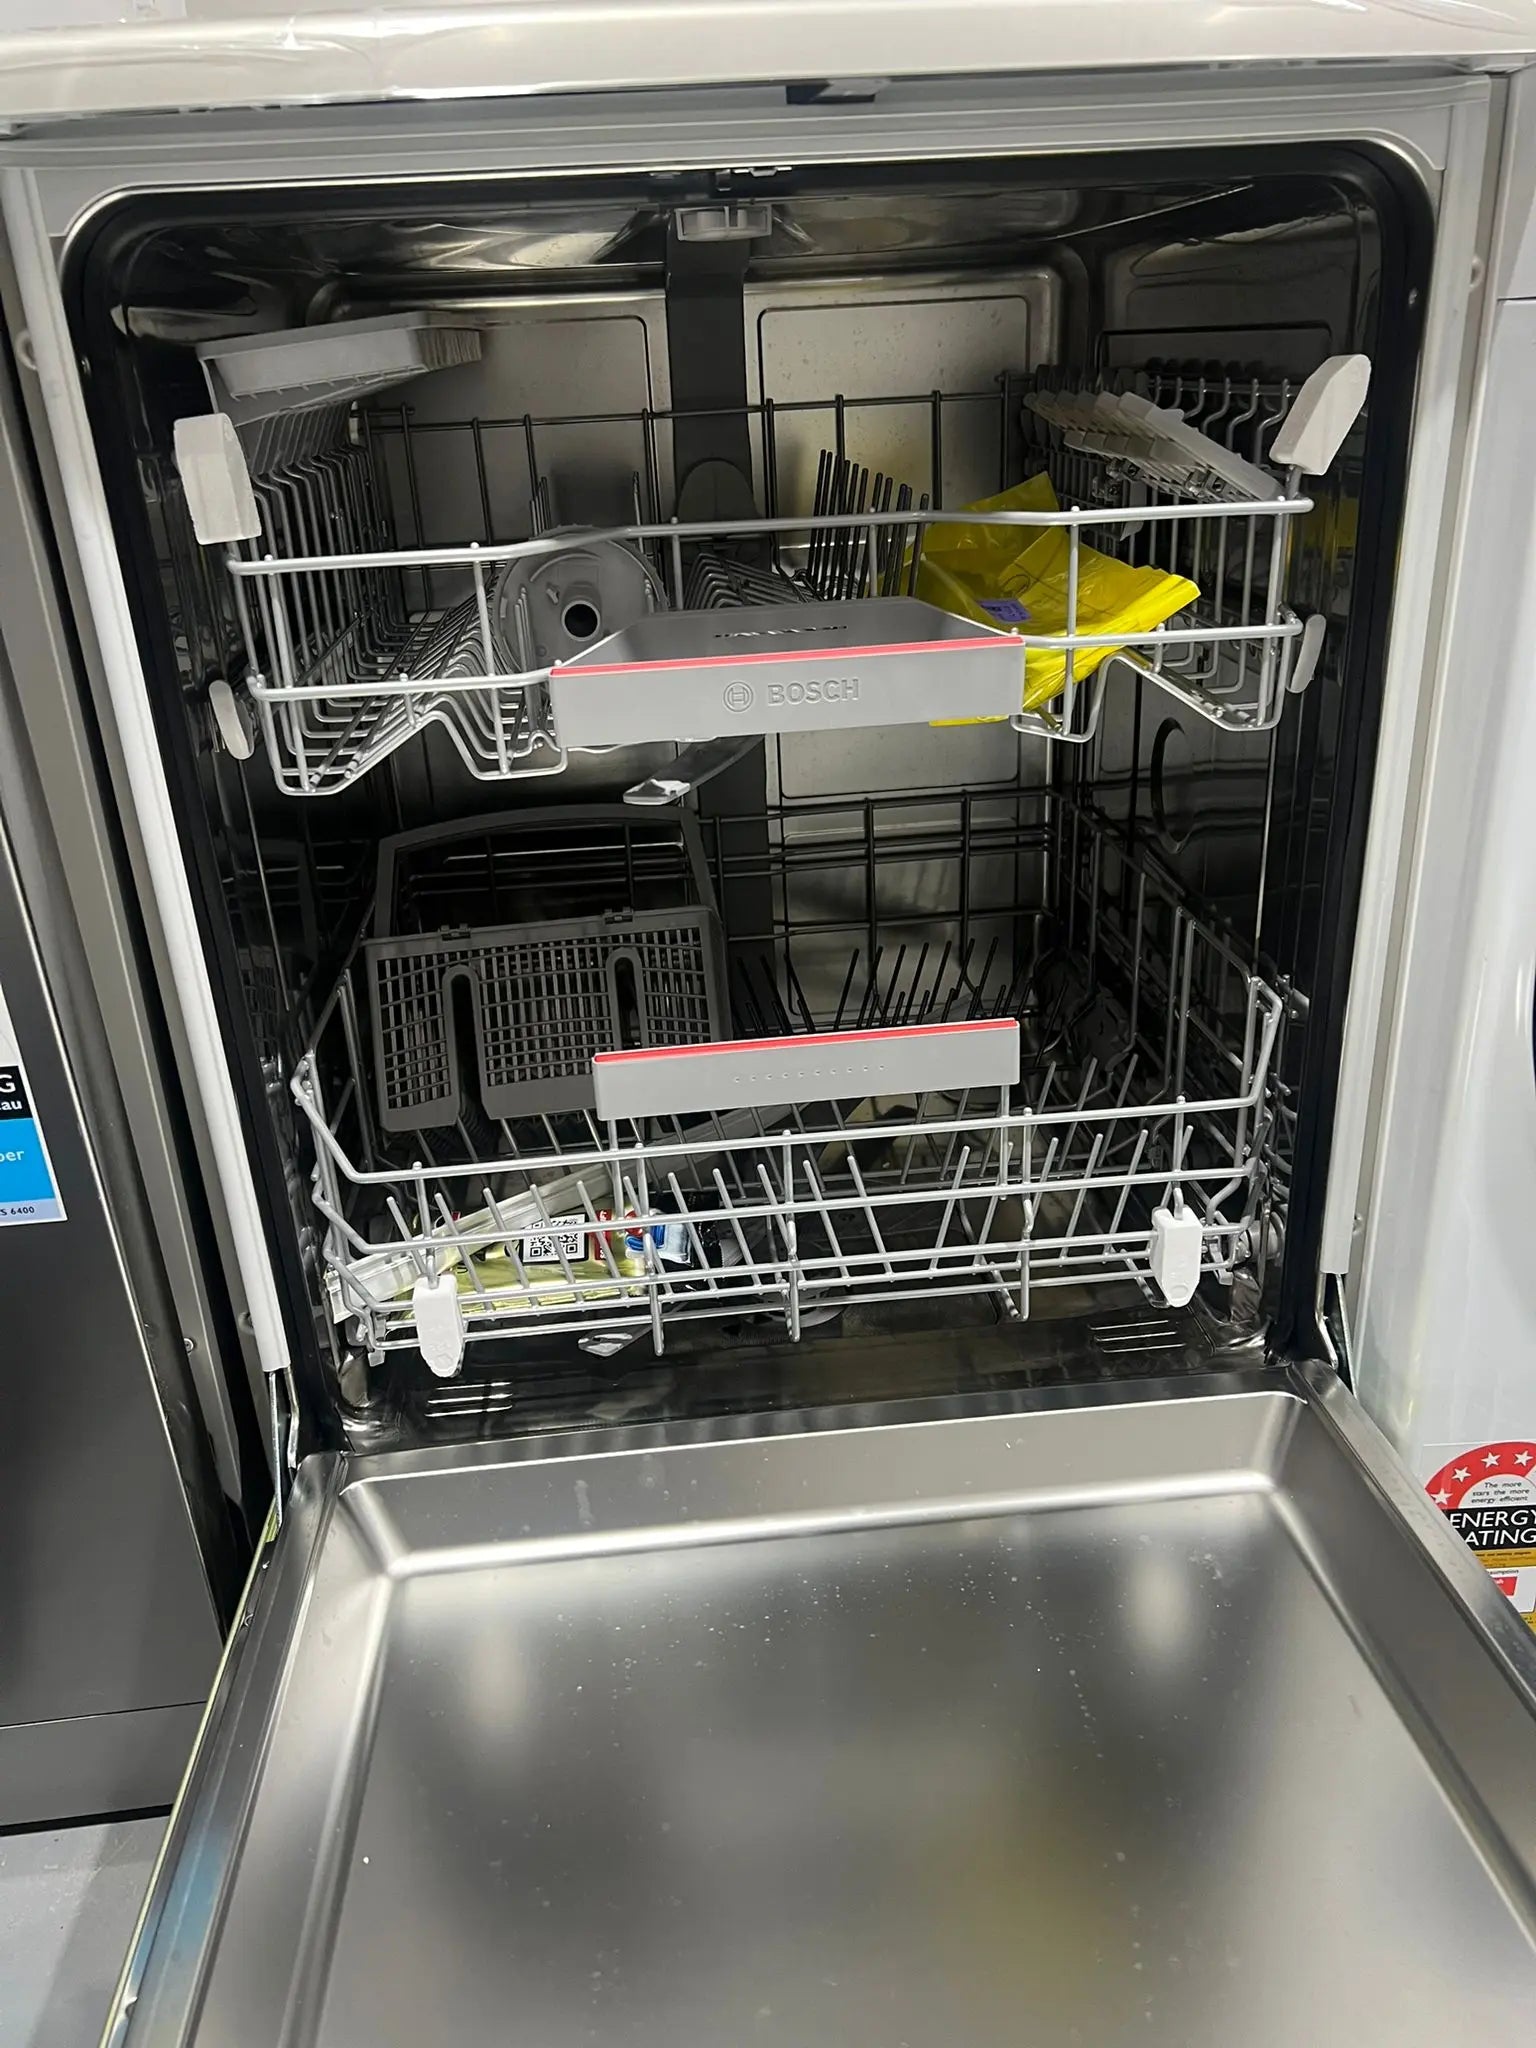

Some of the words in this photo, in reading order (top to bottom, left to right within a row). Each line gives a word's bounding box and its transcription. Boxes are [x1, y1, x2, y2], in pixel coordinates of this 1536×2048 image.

[767, 678, 860, 706] BOSCH
[0, 1074, 16, 1093] G
[10, 1206, 35, 1215] 6400
[1464, 1528, 1536, 1546] ATING
